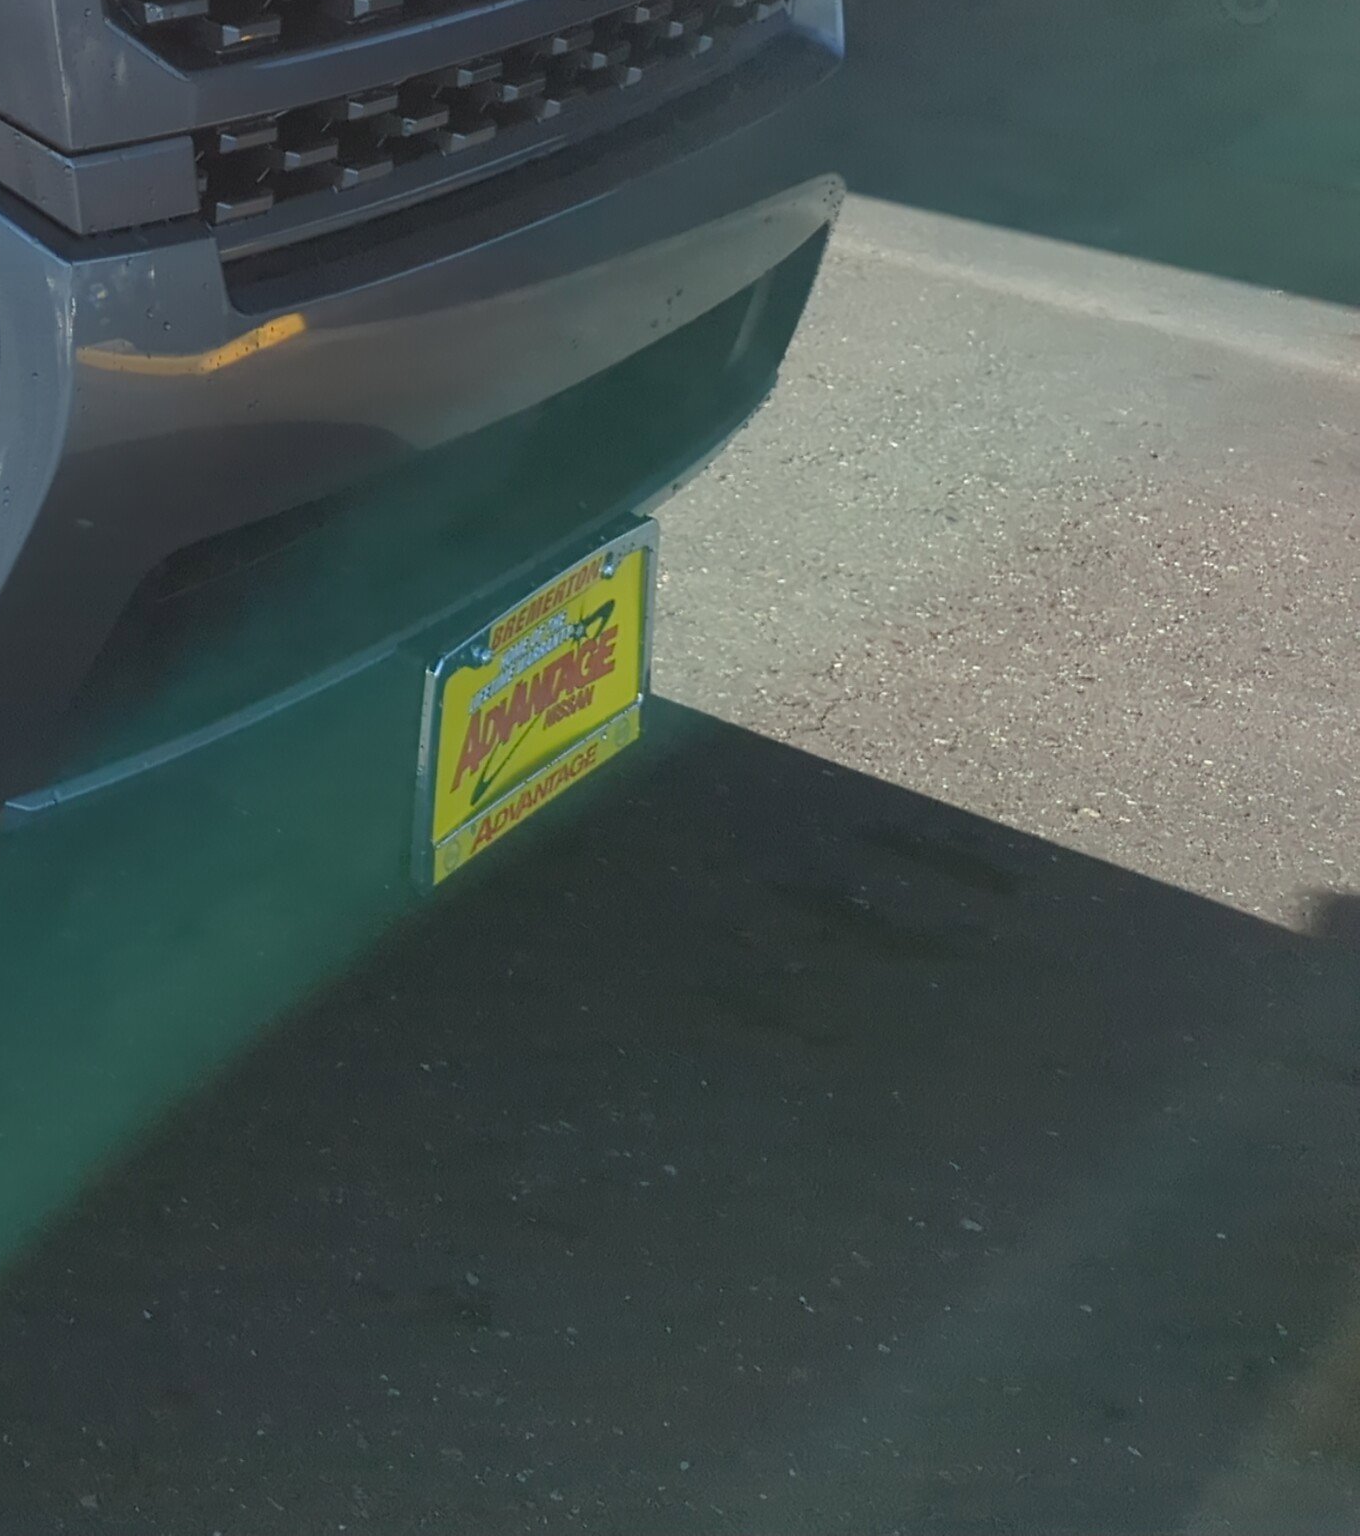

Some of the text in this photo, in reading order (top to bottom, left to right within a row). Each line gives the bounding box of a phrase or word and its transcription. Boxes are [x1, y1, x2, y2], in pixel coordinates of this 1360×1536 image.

[491, 556, 604, 650] BREMERTON
[449, 623, 620, 794] ADVANTAGE
[470, 742, 599, 855] ADVANTAGE
